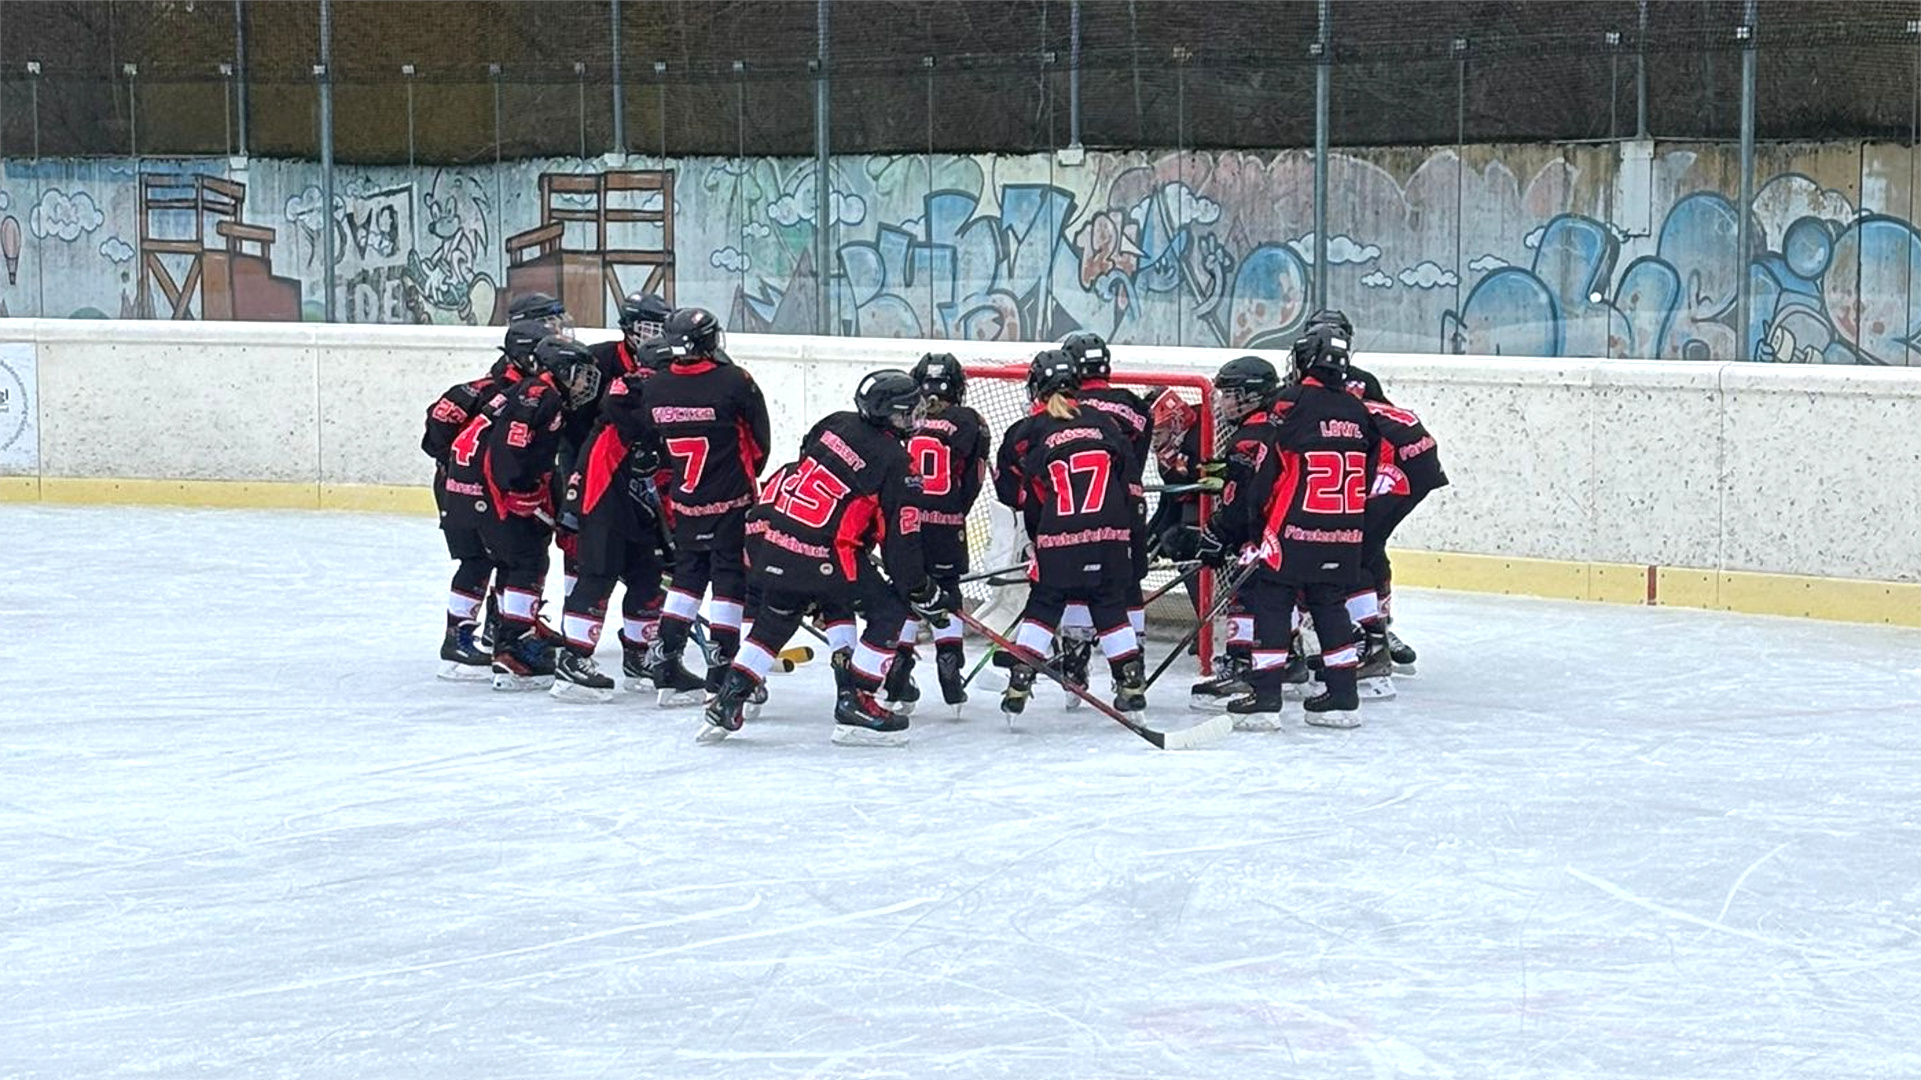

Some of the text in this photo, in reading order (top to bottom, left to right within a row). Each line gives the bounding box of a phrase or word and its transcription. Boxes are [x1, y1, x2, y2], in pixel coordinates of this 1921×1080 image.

[451, 413, 492, 467] 4
[666, 436, 710, 493] 7
[1048, 450, 1111, 516] 17
[1302, 451, 1367, 514] 22
